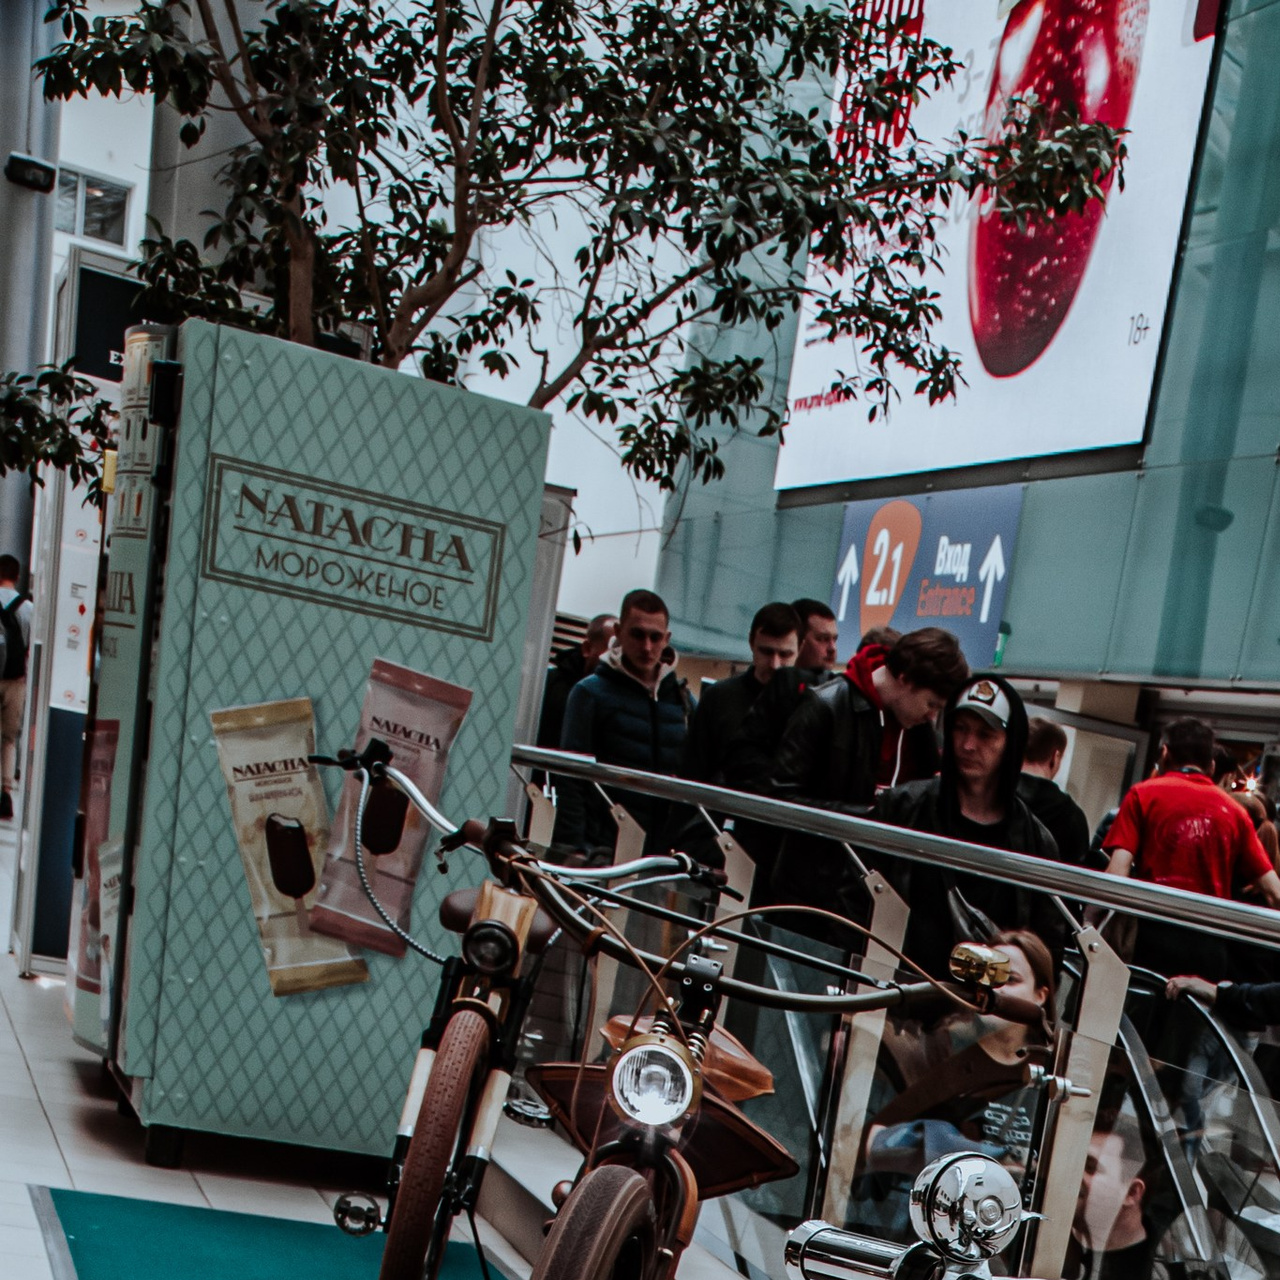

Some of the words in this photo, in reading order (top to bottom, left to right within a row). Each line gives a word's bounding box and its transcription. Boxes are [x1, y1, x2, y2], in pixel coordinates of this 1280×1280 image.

[1128, 313, 1150, 346] 18+
[235, 482, 476, 573] NATACHA
[255, 545, 445, 611] МОРОЖЕНОЕ
[865, 528, 904, 606] 2.1
[934, 535, 972, 583] Вход
[916, 578, 976, 617] Entrance
[370, 716, 441, 750] NATACHA
[232, 757, 309, 778] NATACHA
